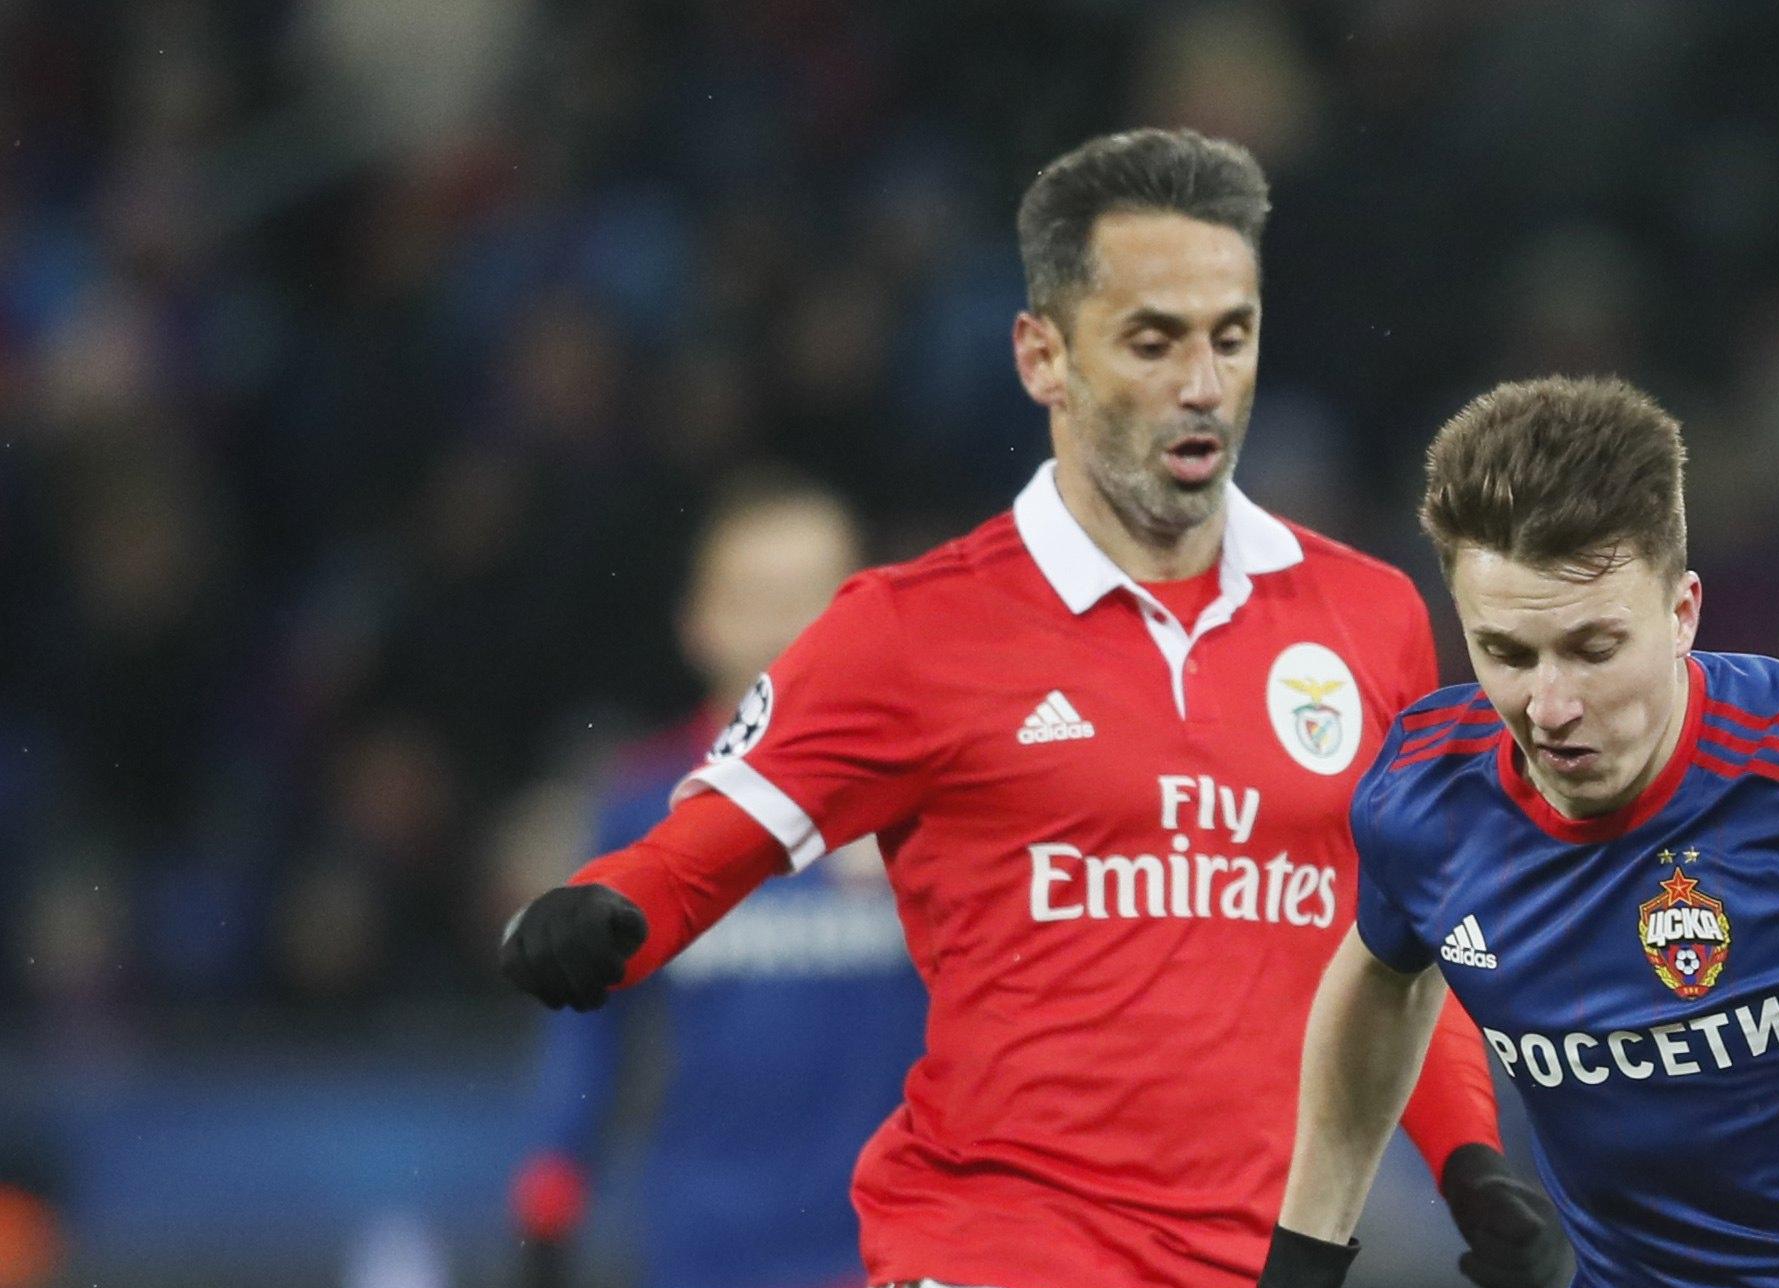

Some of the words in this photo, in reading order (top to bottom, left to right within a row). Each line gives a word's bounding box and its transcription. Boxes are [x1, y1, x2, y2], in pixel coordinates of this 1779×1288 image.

[1016, 720, 1095, 745] adidas
[1158, 774, 1260, 844] Fly
[1027, 834, 1337, 929] Emirates
[1647, 907, 1725, 947] ЦСКА
[1440, 943, 1498, 969] adidas
